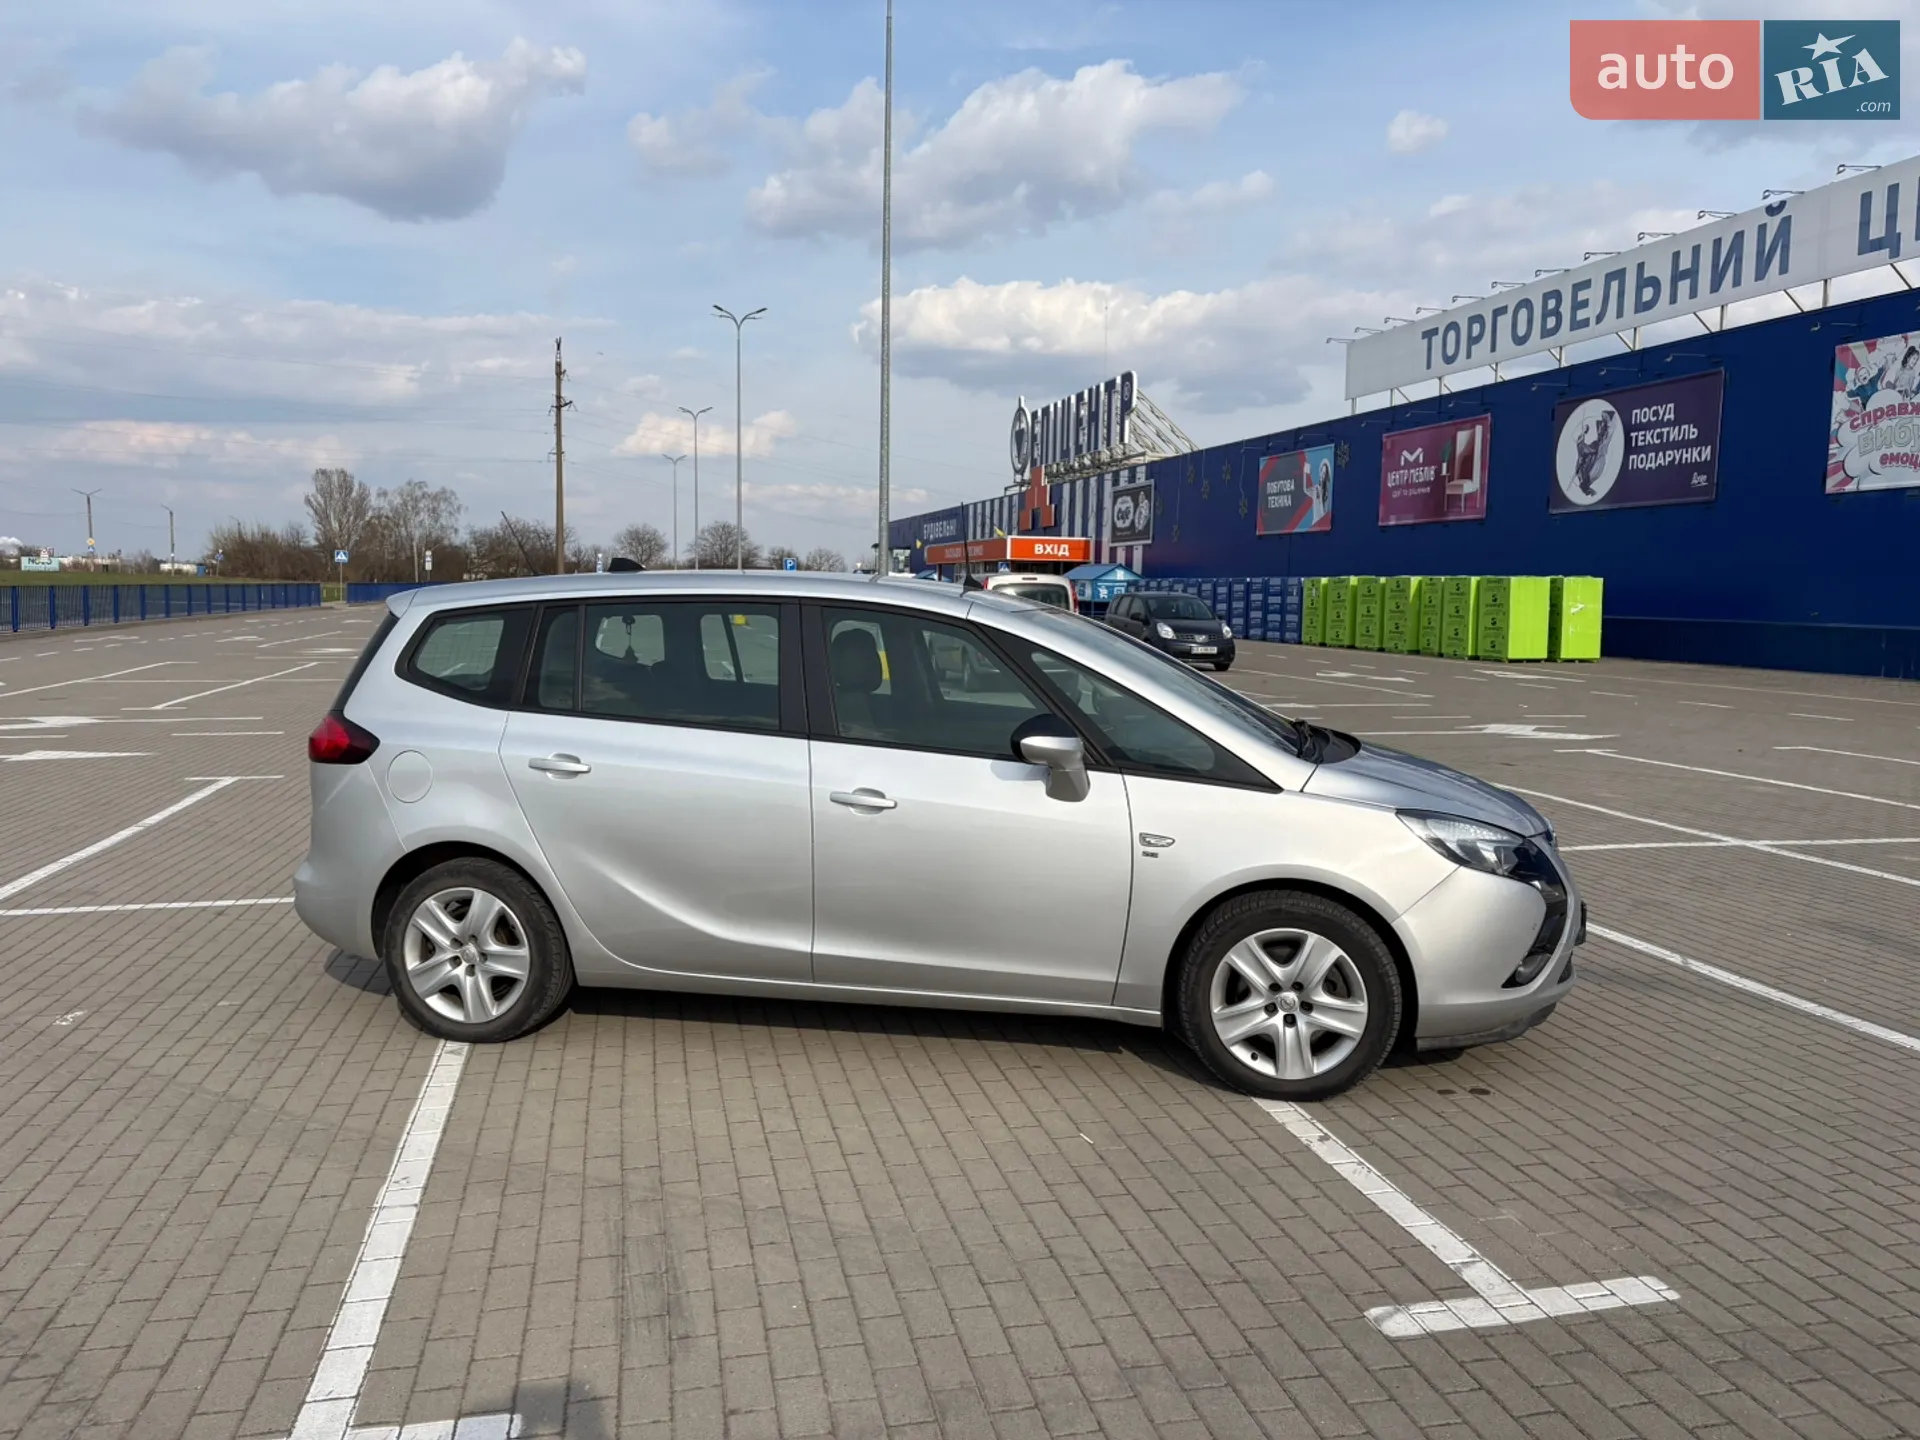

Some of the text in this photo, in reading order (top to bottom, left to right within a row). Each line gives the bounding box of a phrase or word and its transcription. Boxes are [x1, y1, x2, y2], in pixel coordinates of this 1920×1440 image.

[1421, 176, 1920, 371] ТОРГОВЕЛЬНИЙ Ц
[1631, 403, 1675, 425] ПОСУД
[1630, 423, 1698, 447] ТЕКСТИЛЬ
[1628, 445, 1712, 470] ПОДАРУНКИ
[1266, 478, 1295, 494] ПОБУТОВА
[1268, 494, 1292, 508] ТЕХНІКА
[1034, 543, 1070, 557] ВХІД
[786, 559, 795, 571] P
